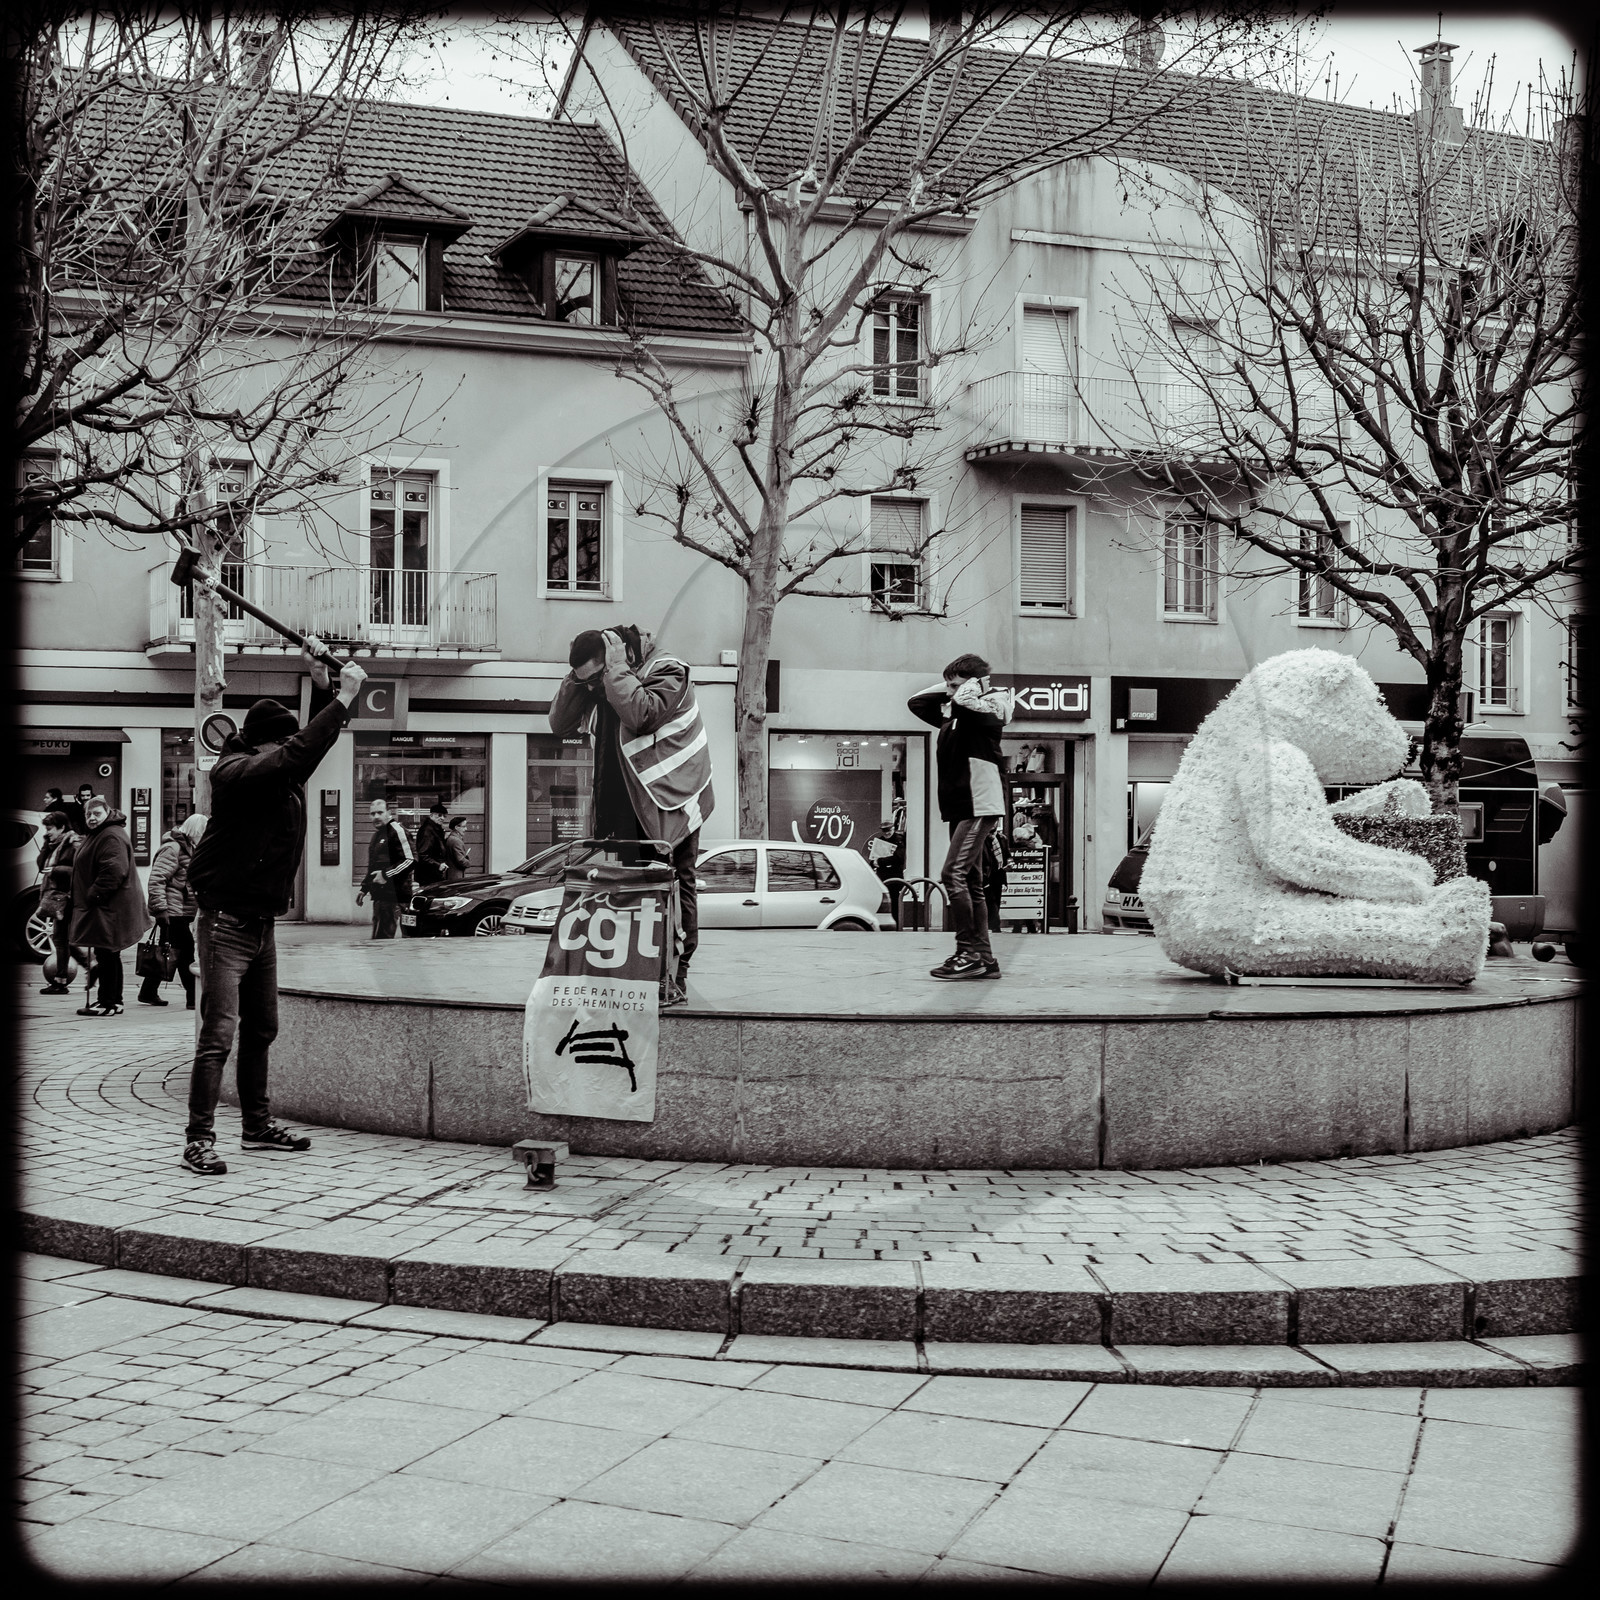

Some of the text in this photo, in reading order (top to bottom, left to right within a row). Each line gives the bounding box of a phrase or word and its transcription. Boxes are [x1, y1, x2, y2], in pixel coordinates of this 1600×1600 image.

[1131, 711, 1155, 720] orange
[814, 806, 841, 814] Jusqu'à
[809, 814, 852, 840] -70%
[558, 897, 663, 969] cgt
[553, 986, 647, 1000] FEDERATION
[552, 998, 573, 1007] DES
